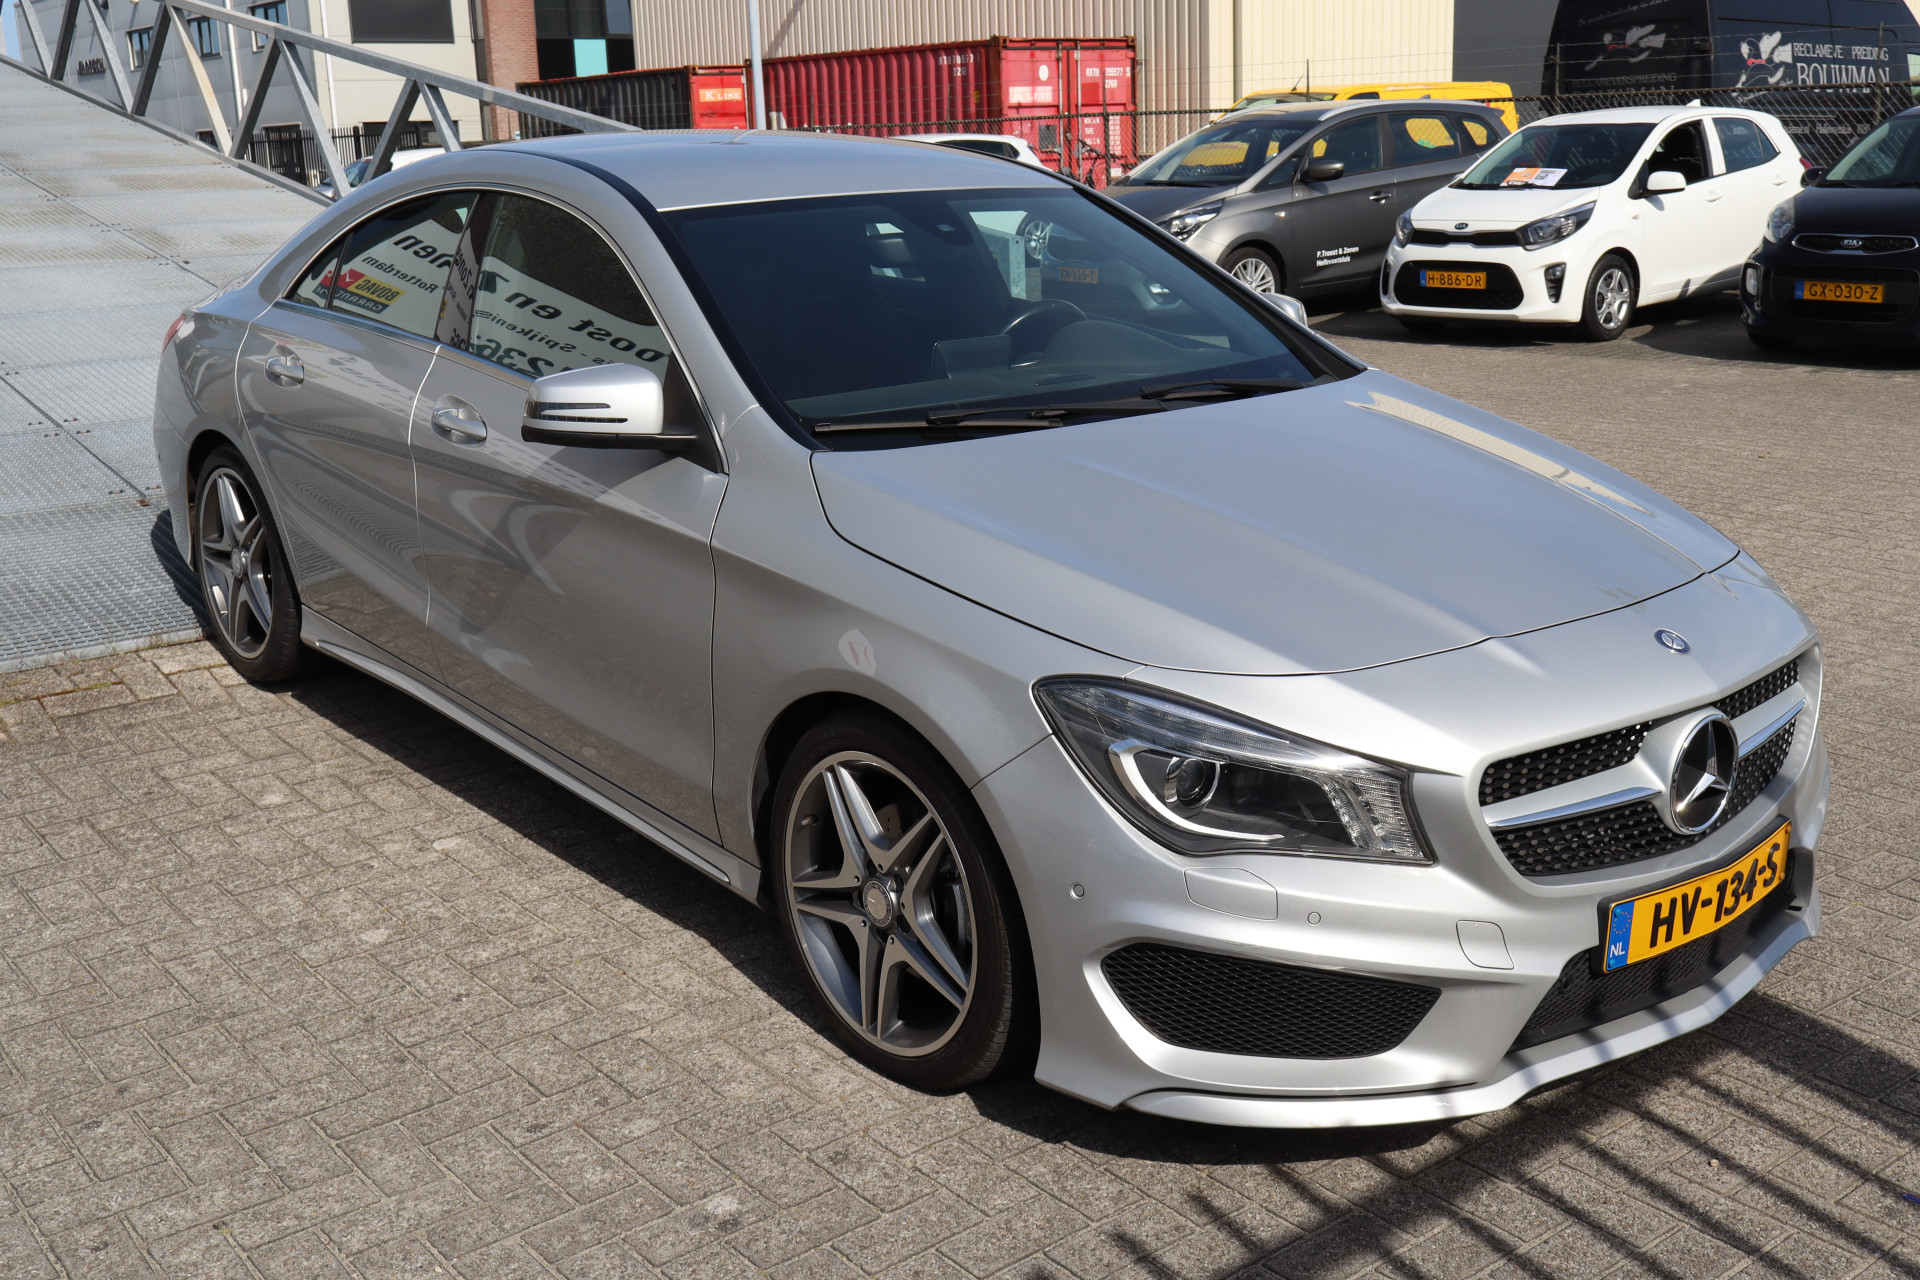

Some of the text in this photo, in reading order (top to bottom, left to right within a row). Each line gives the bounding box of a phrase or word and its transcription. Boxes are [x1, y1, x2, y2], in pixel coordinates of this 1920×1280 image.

[1796, 63, 1890, 94] BOUWMAN
[717, 92, 741, 100] LINE
[1026, 92, 1052, 100] LINE
[1427, 273, 1482, 287] H-886-DR
[1809, 283, 1879, 300] GX-030-Z
[1649, 842, 1781, 948] HV-134-S
[1609, 942, 1626, 958] NL
